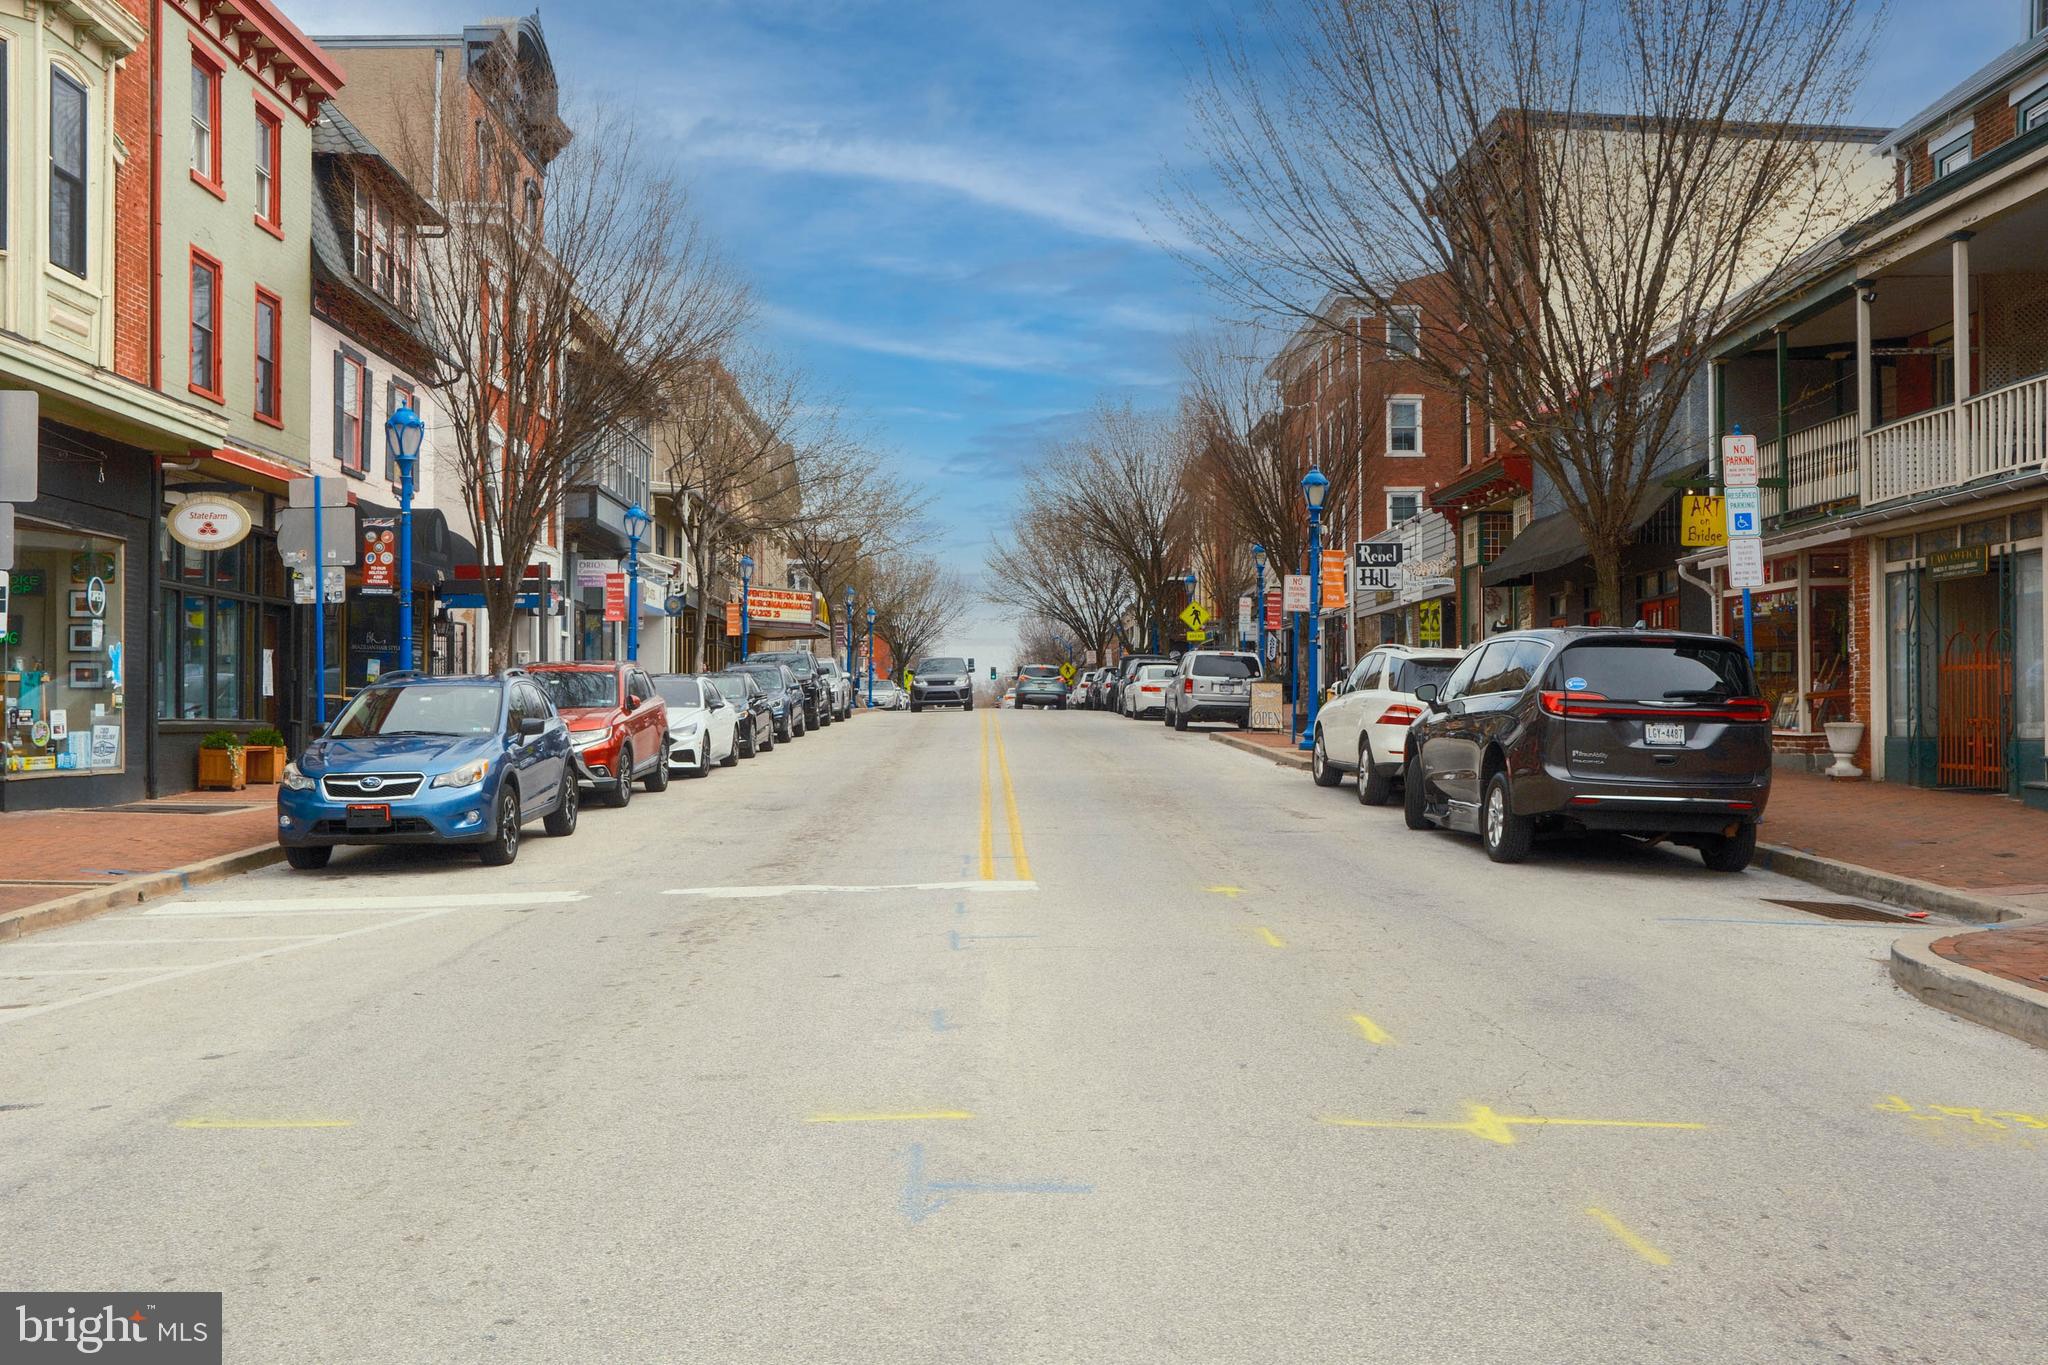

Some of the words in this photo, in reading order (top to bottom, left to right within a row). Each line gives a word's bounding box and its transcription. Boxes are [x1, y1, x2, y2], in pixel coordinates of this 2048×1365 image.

[1733, 445, 1746, 454] NO
[1726, 455, 1755, 466] PARKING
[1690, 496, 1725, 517] ART
[1700, 518, 1711, 526] on
[1688, 526, 1722, 546] Bridge
[579, 561, 607, 569] ORION
[1293, 577, 1303, 586] NO
[1360, 568, 1397, 589] Hill
[1253, 711, 1281, 726] OPEN
